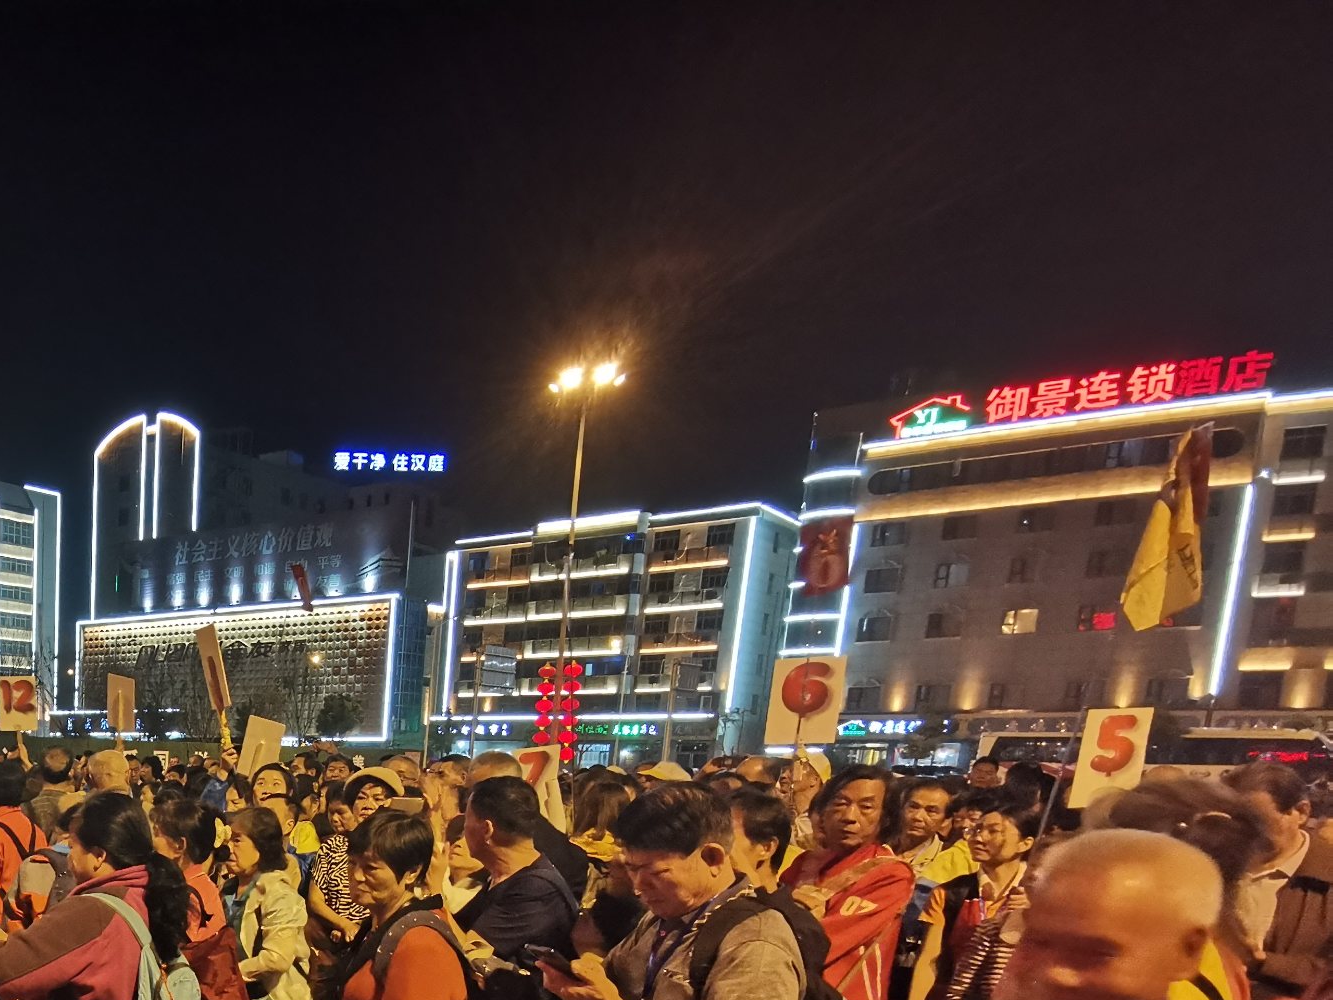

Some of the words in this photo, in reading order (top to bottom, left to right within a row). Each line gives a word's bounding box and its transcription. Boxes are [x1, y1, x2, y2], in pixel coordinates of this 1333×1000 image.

[985, 349, 1275, 424] 御景连锁酒店
[334, 451, 386, 471] 爱干净
[392, 453, 445, 472] 住汉庭
[175, 522, 334, 566] 社会主义核心价值观
[318, 554, 342, 569] 平等
[0, 679, 36, 714] 12
[781, 661, 831, 715] 6
[1089, 714, 1138, 775] 5
[518, 750, 550, 787] 7
[839, 895, 879, 917] 07
